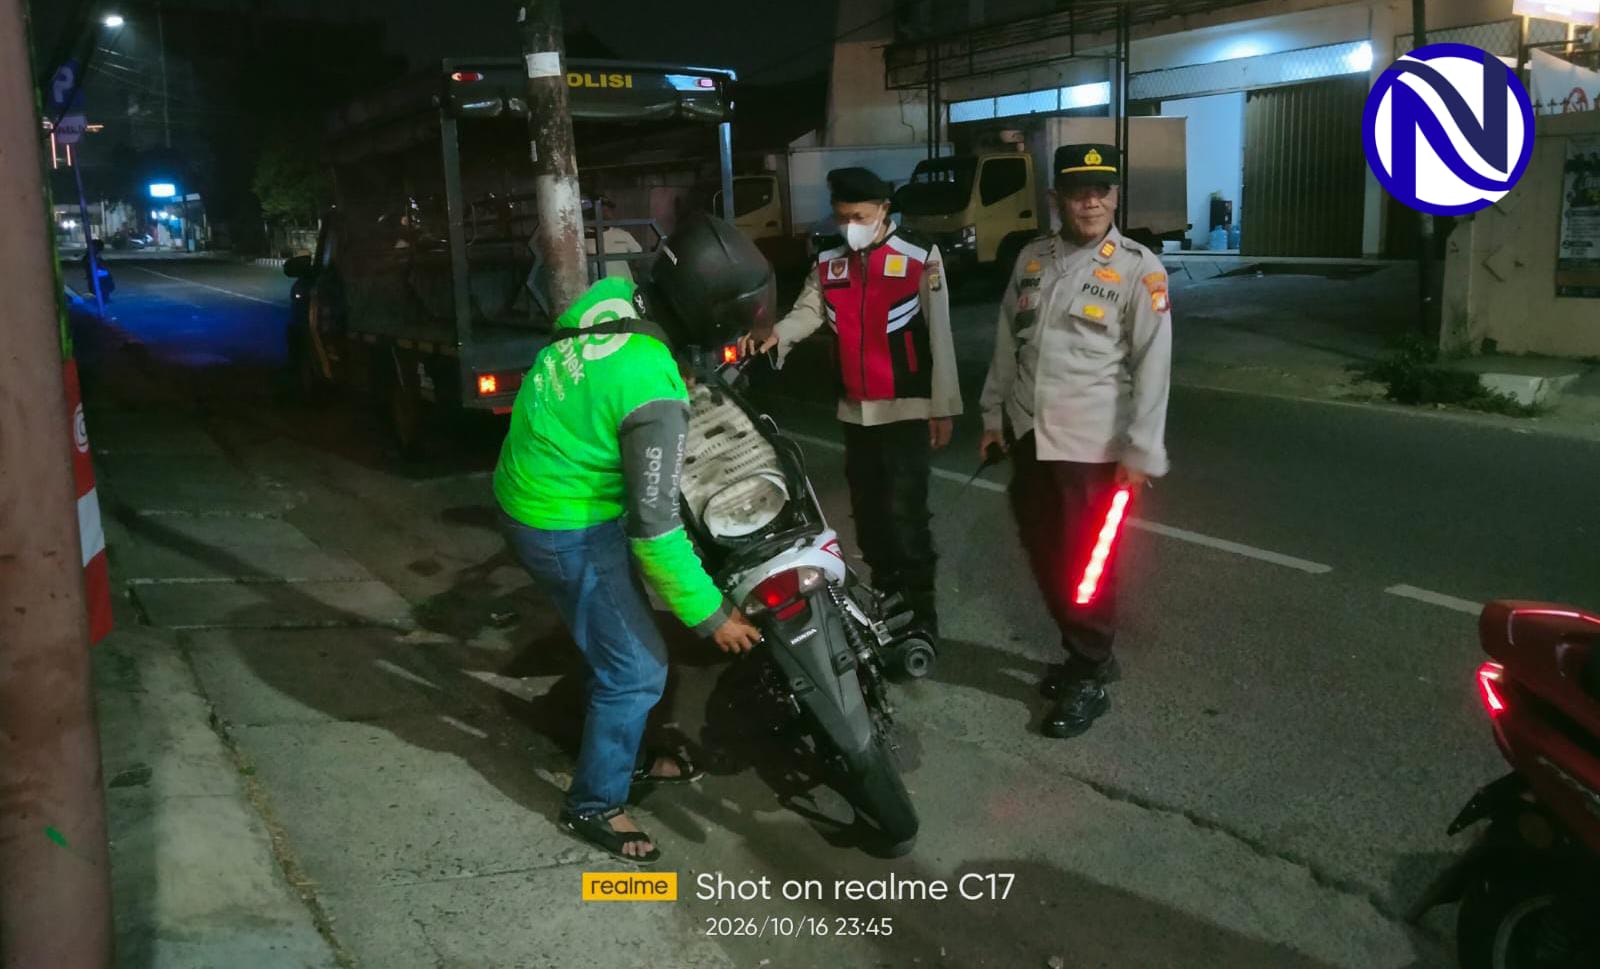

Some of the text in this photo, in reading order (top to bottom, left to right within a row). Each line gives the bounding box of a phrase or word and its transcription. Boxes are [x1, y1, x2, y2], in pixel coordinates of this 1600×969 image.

[566, 73, 633, 88] OLISI
[1081, 283, 1120, 303] POLRI
[641, 446, 663, 509] gopay
